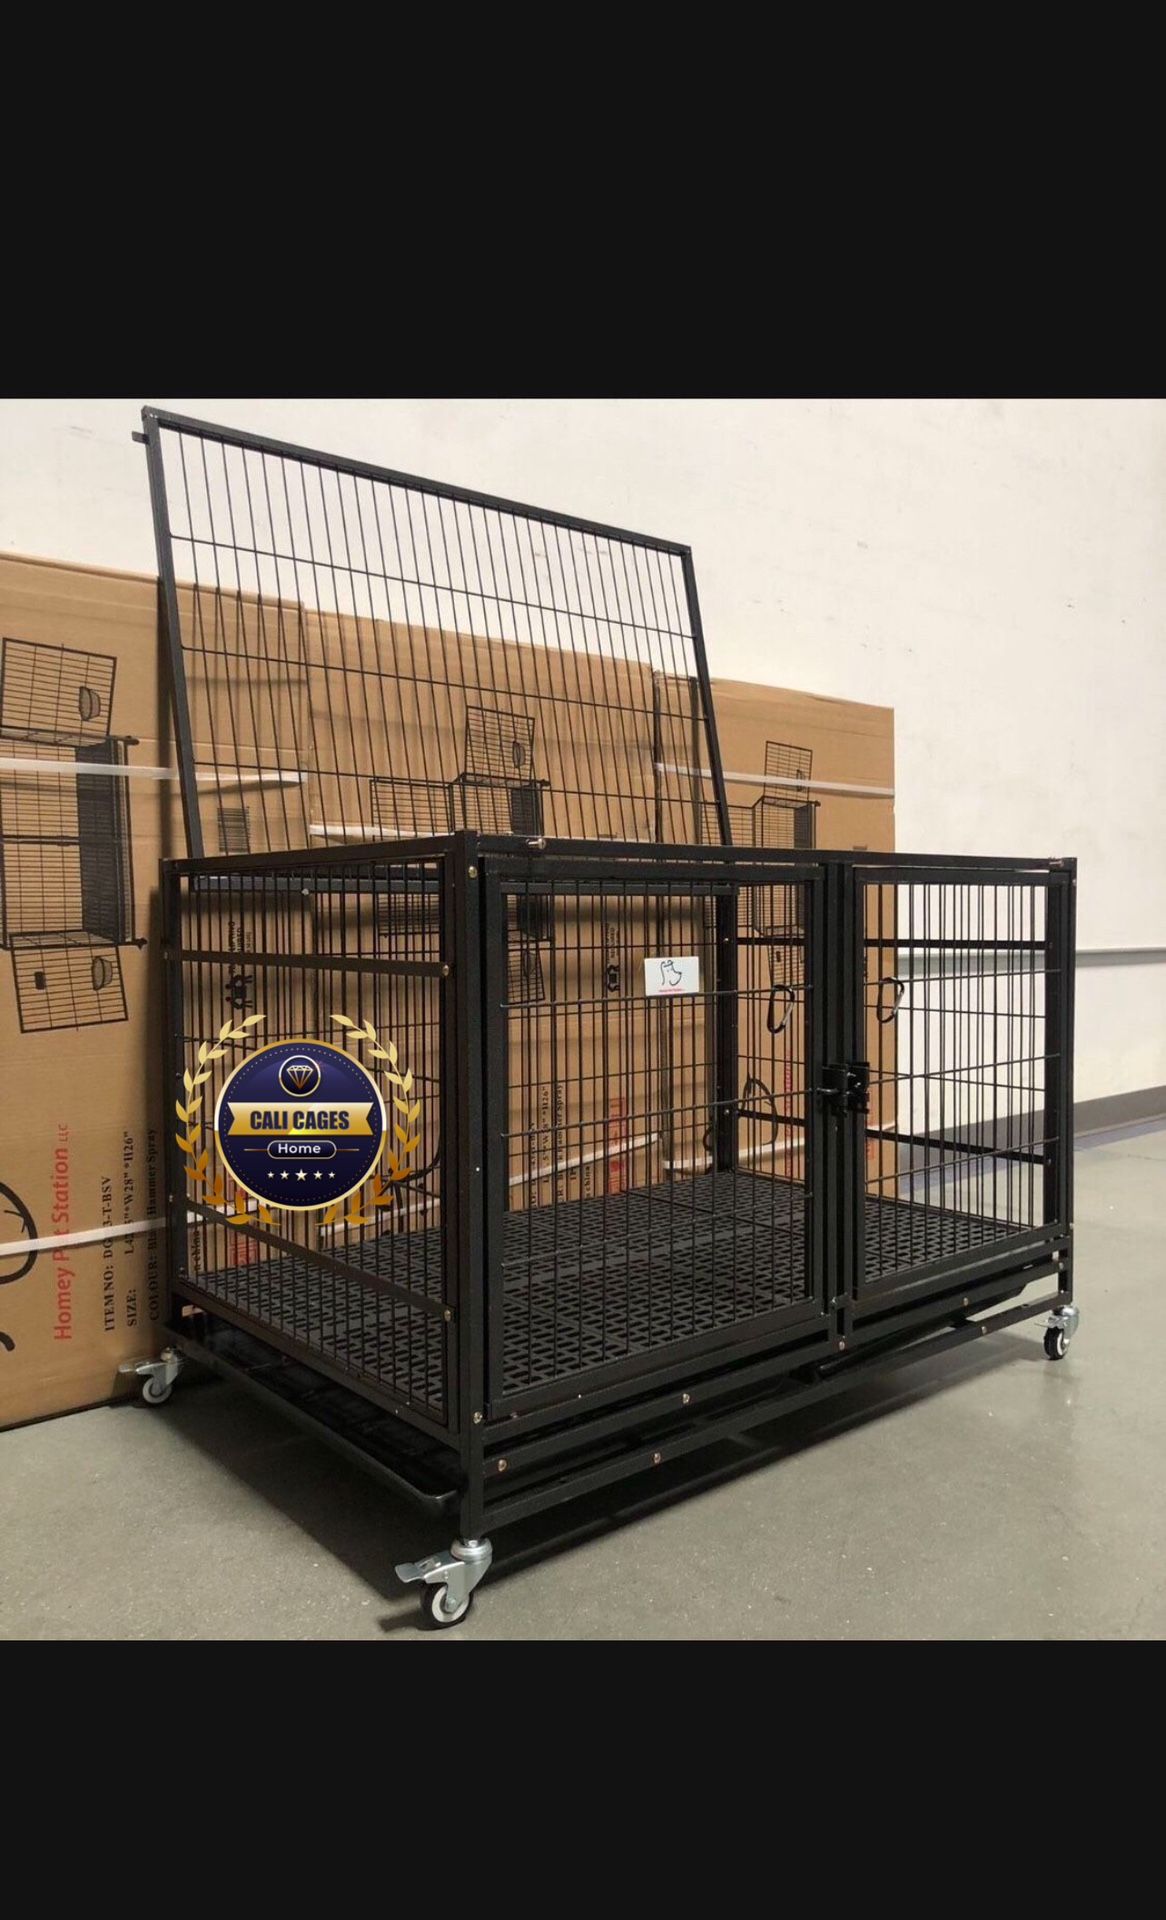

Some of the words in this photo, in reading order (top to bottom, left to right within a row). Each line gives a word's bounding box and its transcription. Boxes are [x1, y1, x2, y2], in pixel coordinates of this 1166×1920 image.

[145, 1128, 159, 1163] Spray
[50, 1148, 70, 1223] Station
[52, 1227, 70, 1262] Pt
[103, 1264, 114, 1291] NO:
[148, 1256, 161, 1321] COLOUR:
[53, 1267, 76, 1341] Homey
[104, 1293, 115, 1332] ITEM
[127, 1288, 138, 1327] SIZE:
